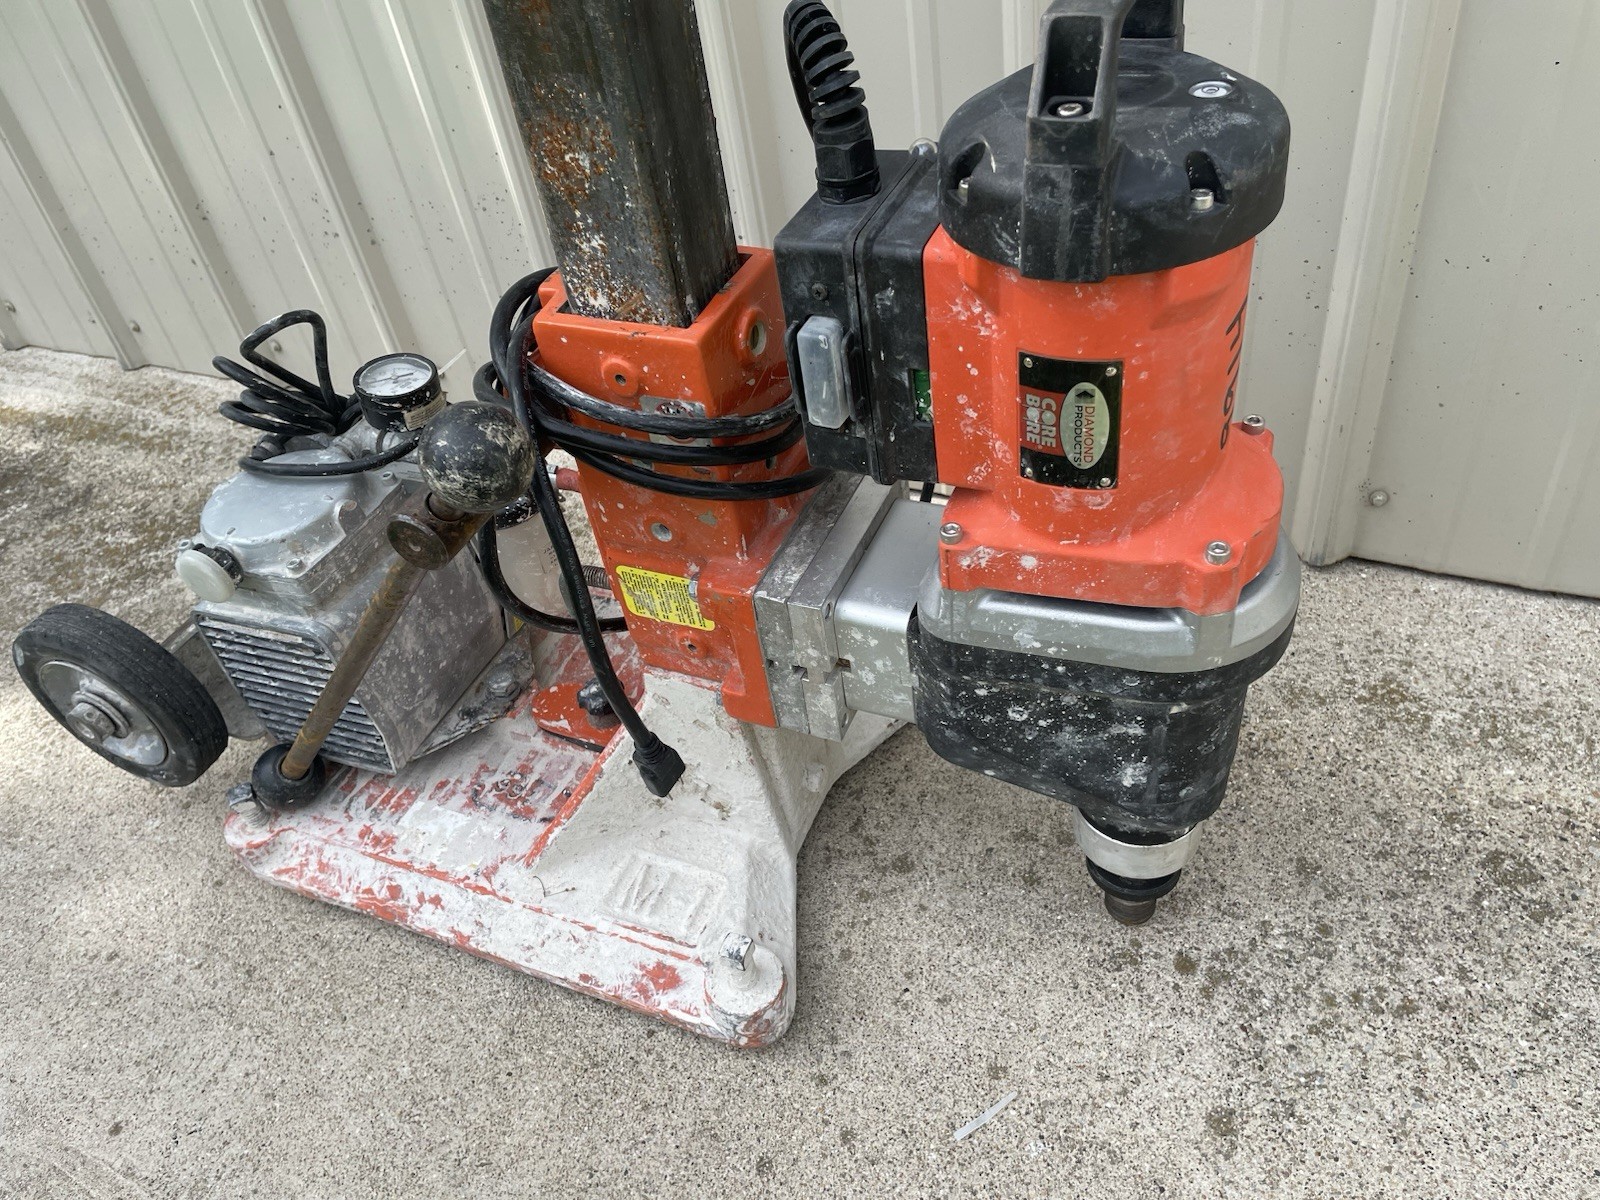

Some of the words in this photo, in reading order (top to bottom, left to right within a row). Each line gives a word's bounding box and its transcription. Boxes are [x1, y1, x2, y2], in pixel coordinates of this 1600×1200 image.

[1025, 393, 1041, 445] BORE
[1041, 398, 1056, 447] CORE
[1073, 405, 1083, 464] PRODUCTS
[1083, 405, 1096, 463] DIAMOND
